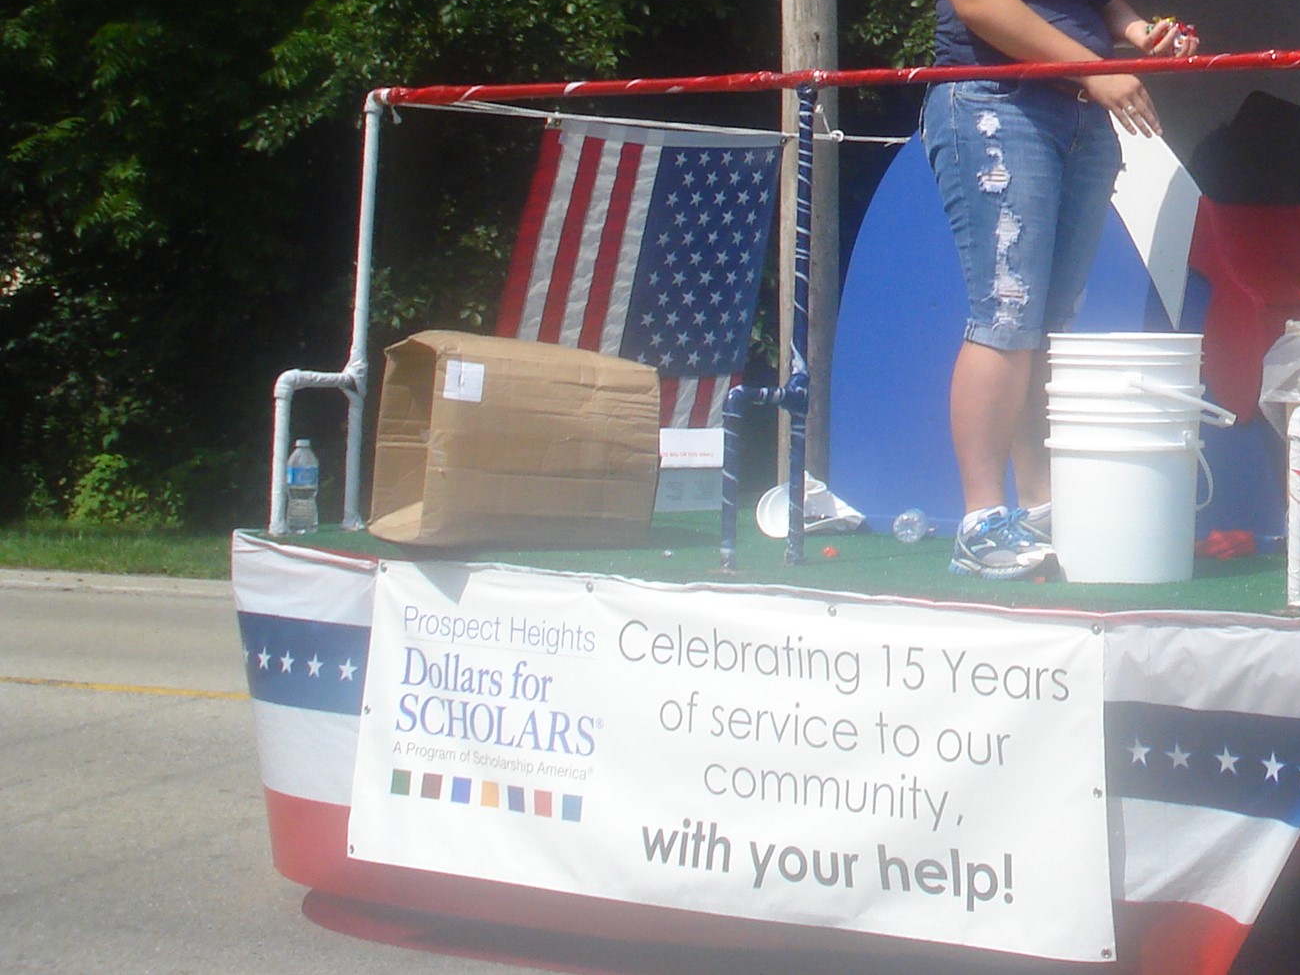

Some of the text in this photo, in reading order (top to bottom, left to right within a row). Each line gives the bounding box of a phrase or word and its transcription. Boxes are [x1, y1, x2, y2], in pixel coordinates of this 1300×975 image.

[403, 605, 596, 655] Prospect Heights
[619, 619, 1070, 702] Celebrating 15 Years
[400, 646, 553, 703] Dollars for
[393, 740, 402, 754] A
[406, 741, 456, 762] Program
[460, 749, 470, 763] of
[473, 750, 534, 775] Scholarship
[660, 691, 1011, 766] of service to our
[703, 763, 963, 832] community,
[642, 818, 1014, 912] with your help!
